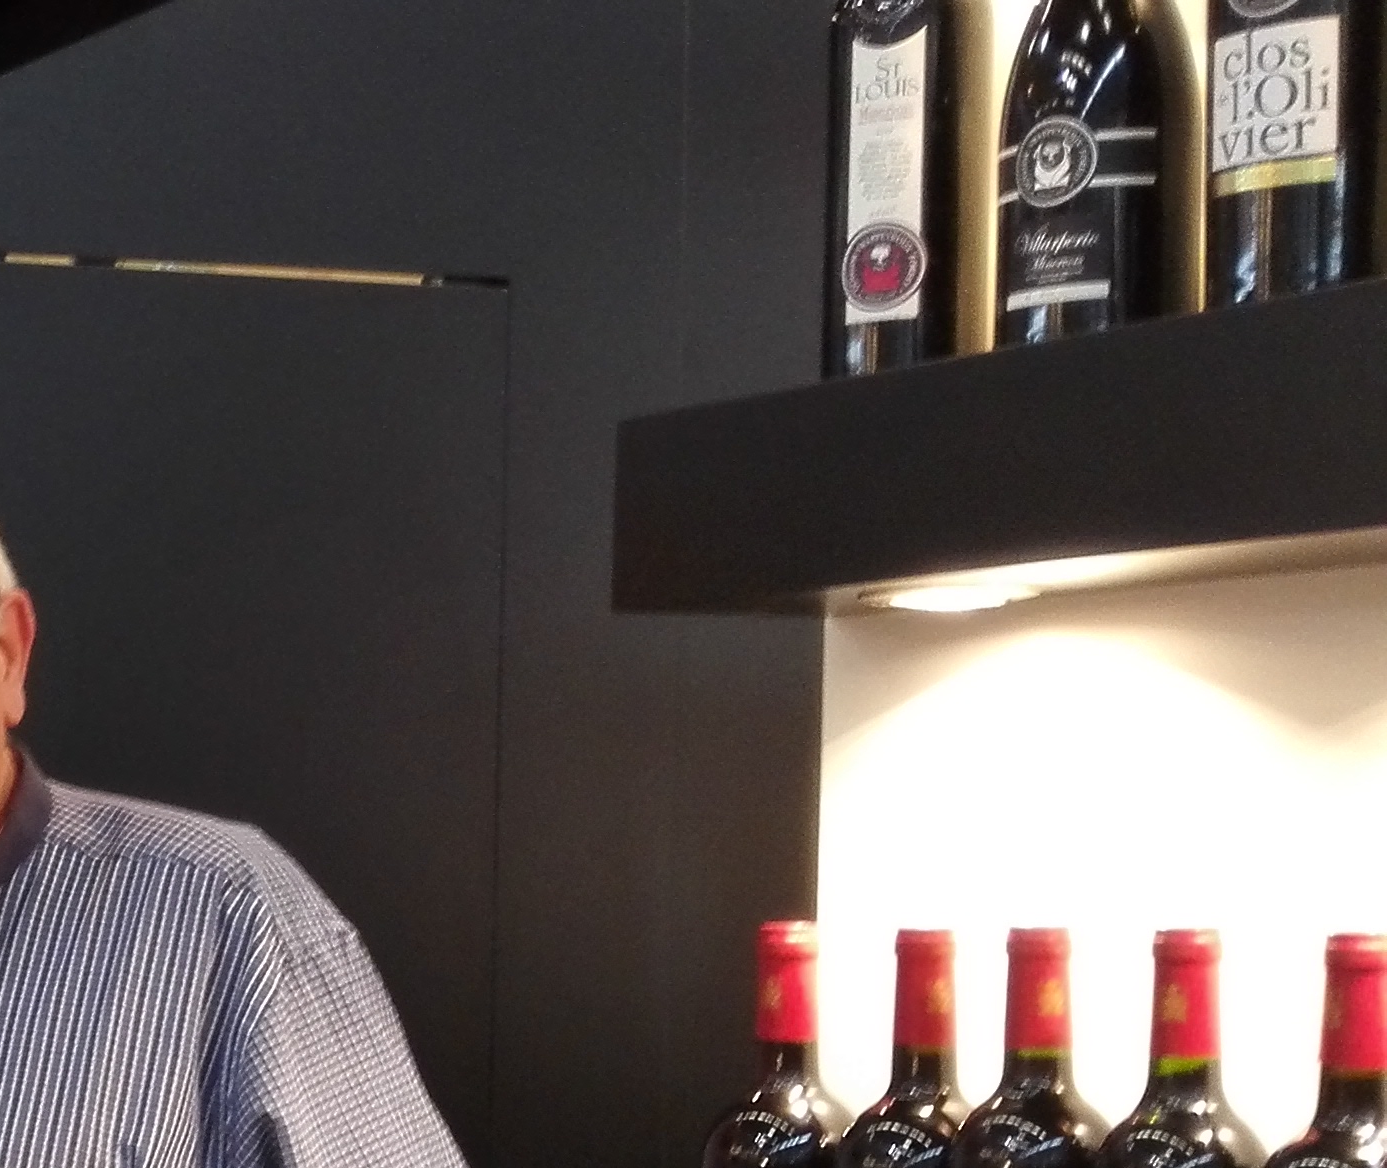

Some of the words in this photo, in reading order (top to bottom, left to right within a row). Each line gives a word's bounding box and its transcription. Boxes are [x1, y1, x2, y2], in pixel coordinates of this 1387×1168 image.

[1223, 32, 1311, 82] clos
[854, 78, 920, 104] LOUIS
[1218, 116, 1318, 163] vier
